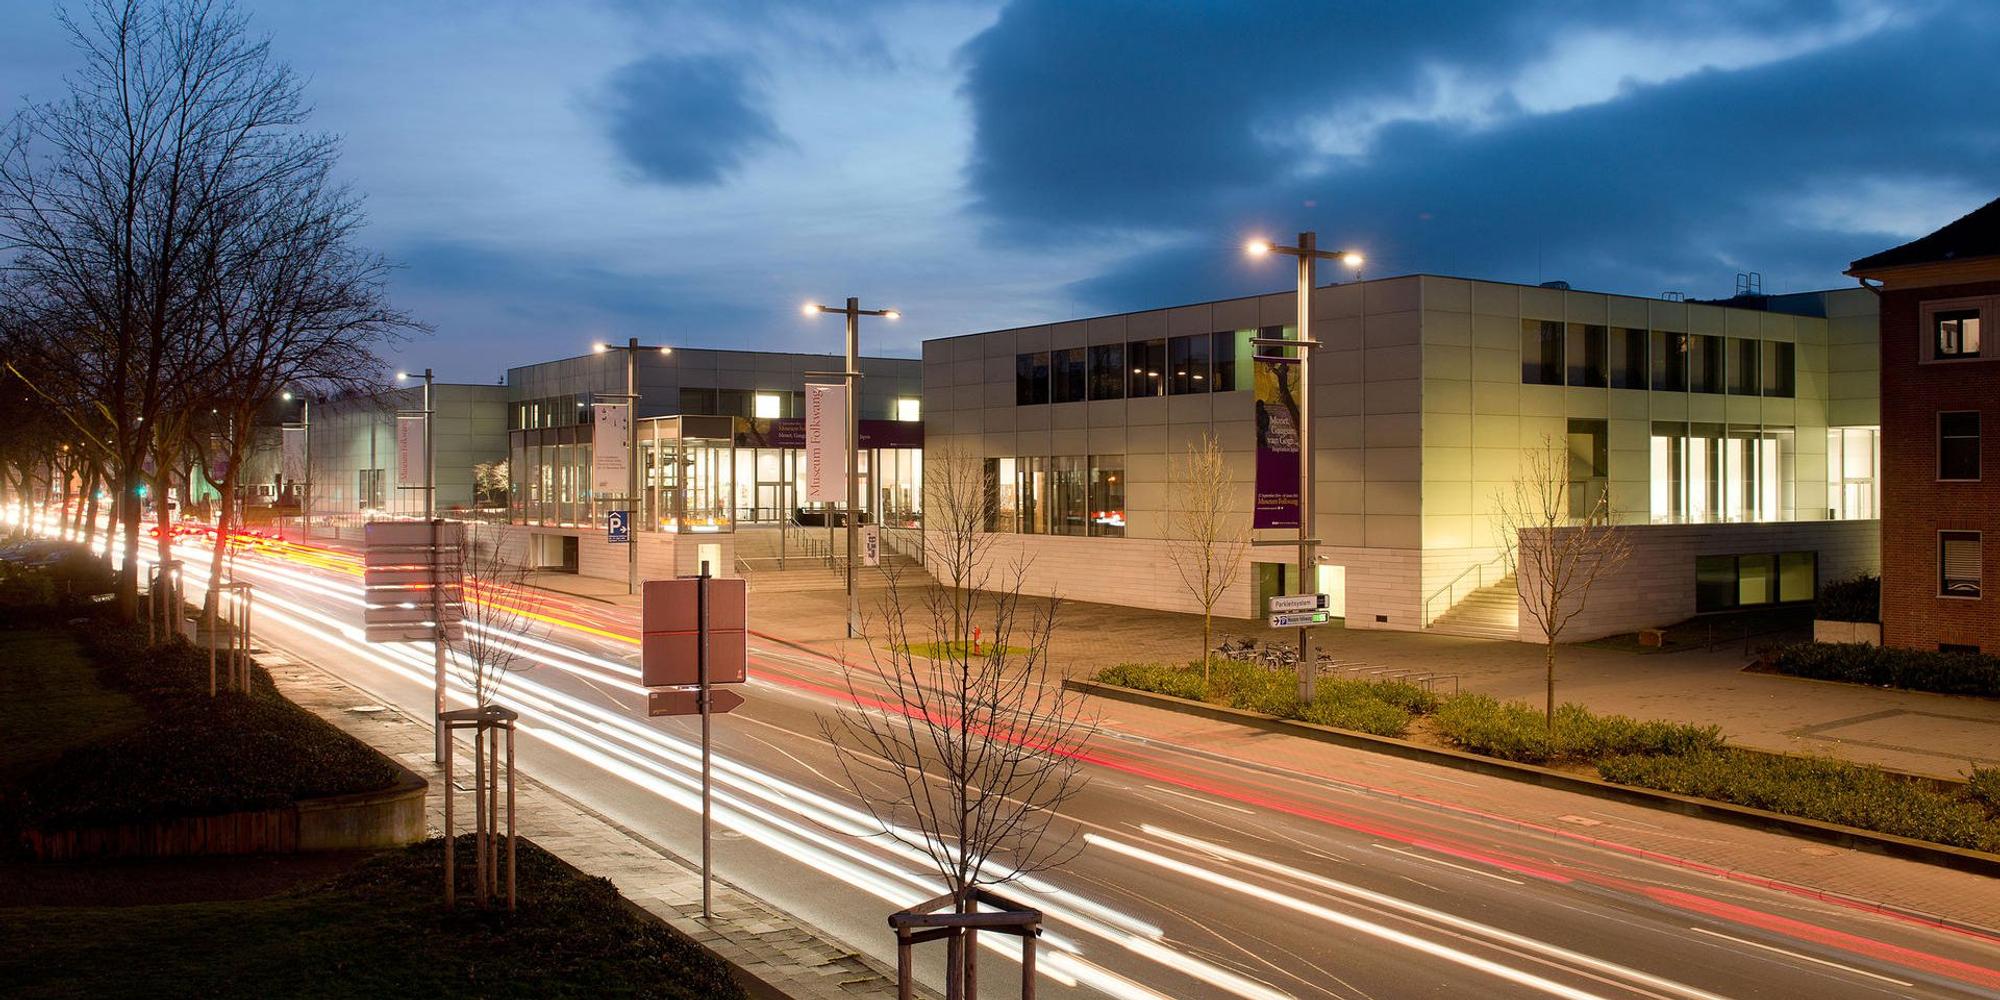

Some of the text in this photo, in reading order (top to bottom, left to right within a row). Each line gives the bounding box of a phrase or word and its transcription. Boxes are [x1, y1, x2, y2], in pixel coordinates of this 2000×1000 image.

[809, 389, 823, 497] Museum Folkwang
[610, 517, 621, 534] P
